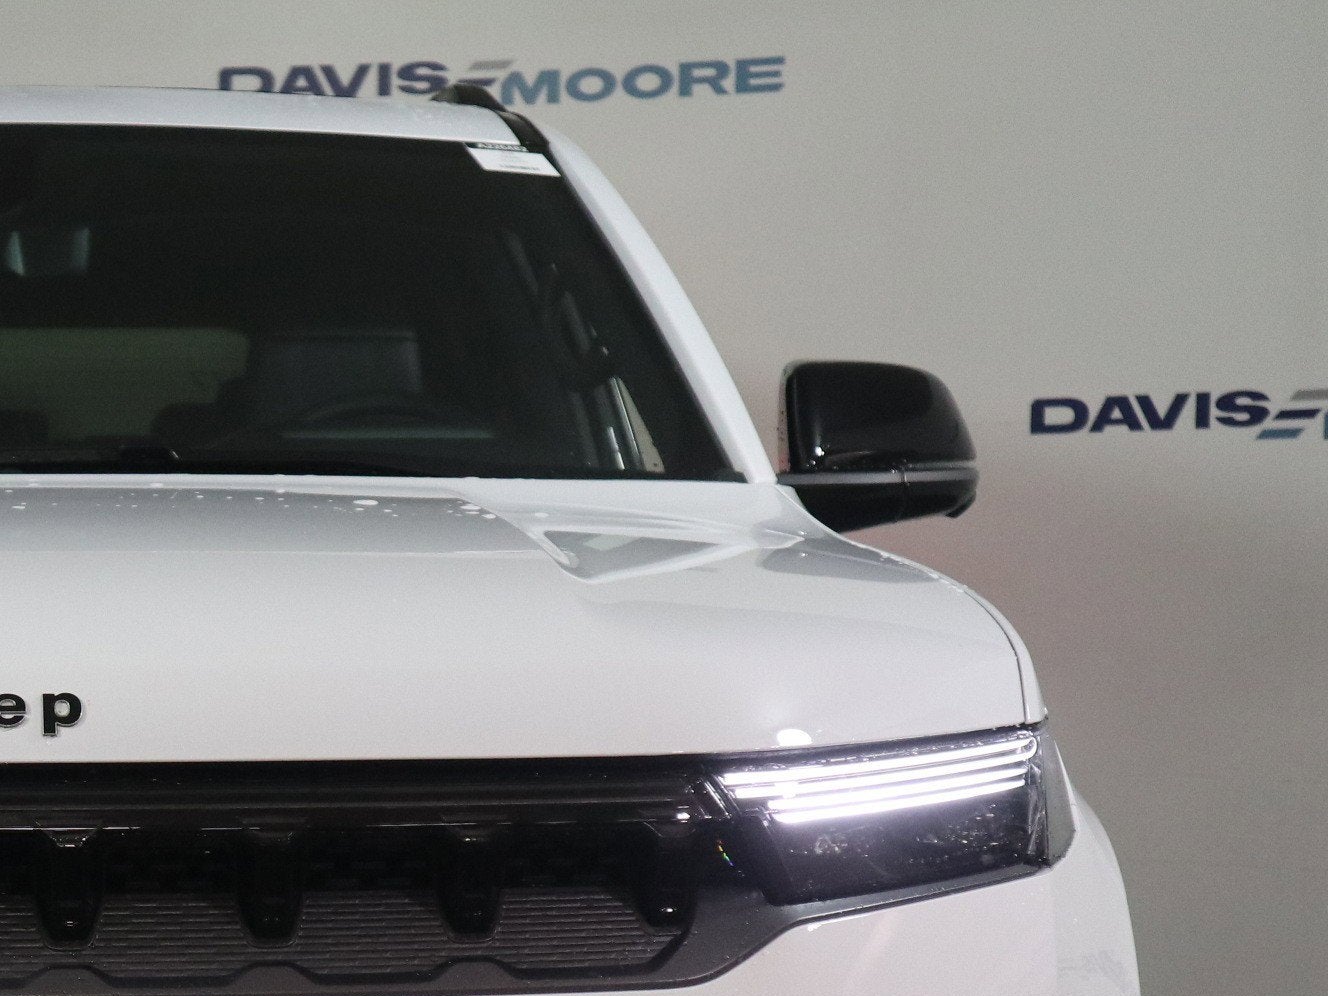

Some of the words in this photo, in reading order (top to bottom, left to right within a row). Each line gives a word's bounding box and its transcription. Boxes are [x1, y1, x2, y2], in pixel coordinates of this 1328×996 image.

[217, 60, 449, 98] DAVIS
[500, 56, 786, 106] MOORE
[1029, 390, 1271, 434] DAVIS
